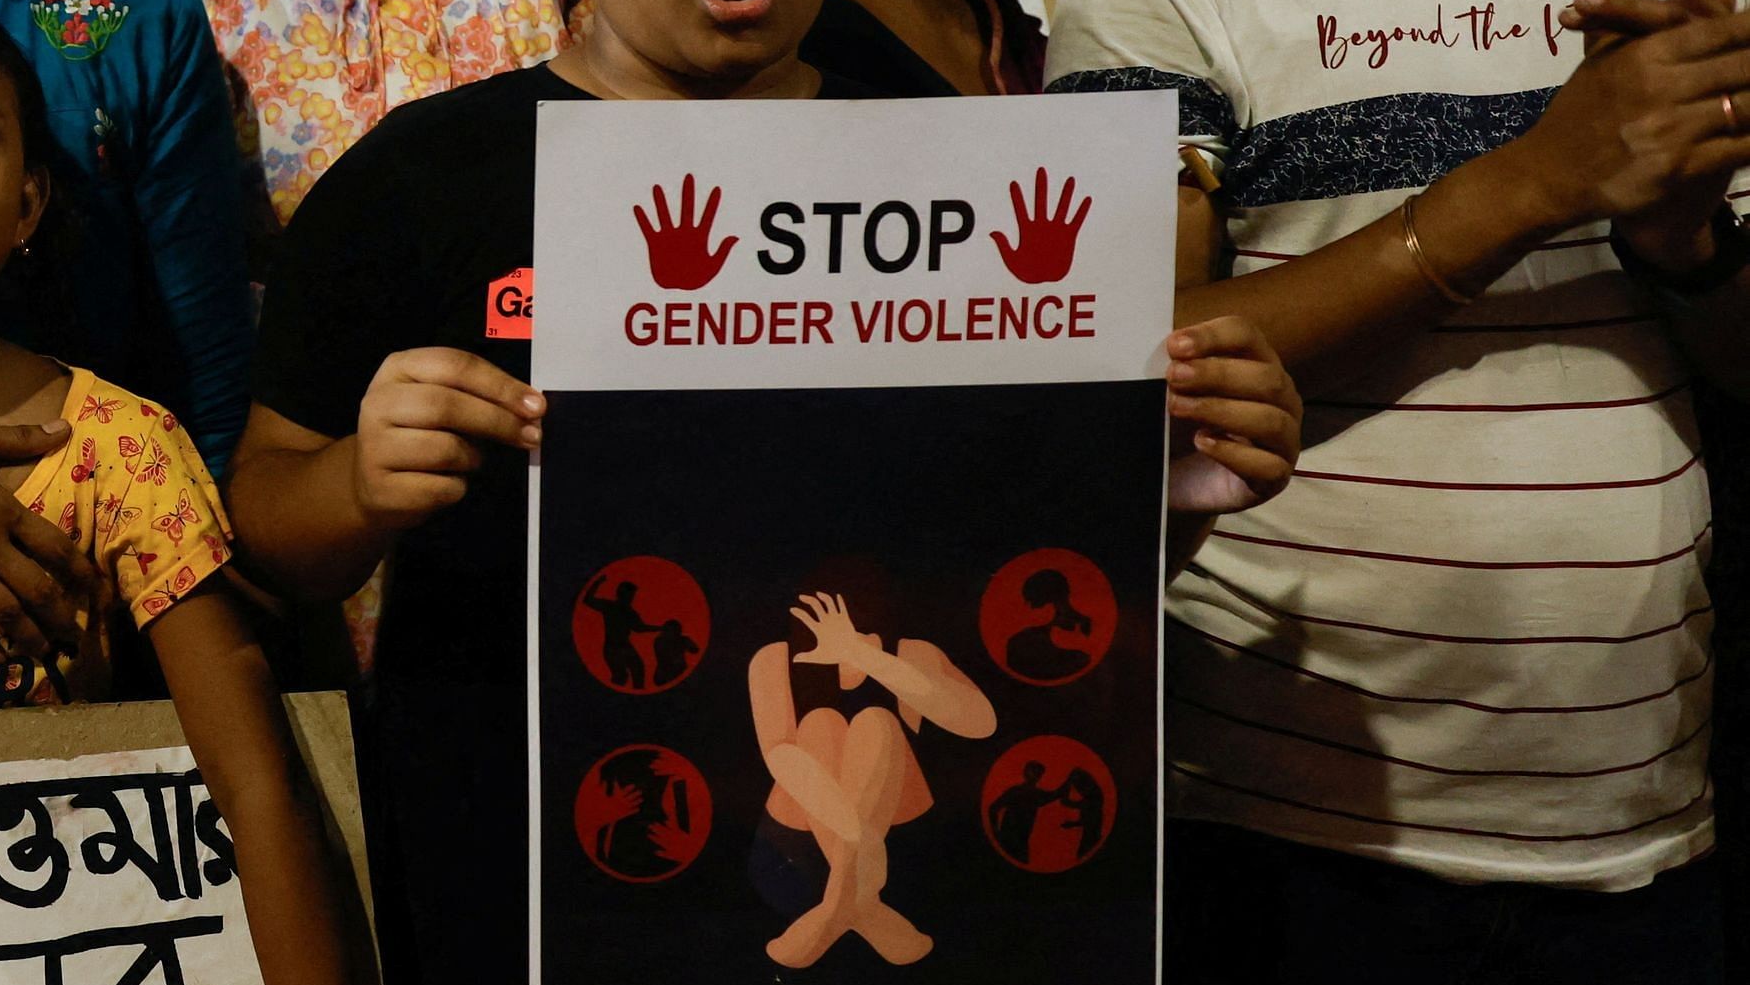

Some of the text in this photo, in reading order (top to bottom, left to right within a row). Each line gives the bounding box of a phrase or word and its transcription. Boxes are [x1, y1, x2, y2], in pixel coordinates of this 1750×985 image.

[1317, 3, 1459, 69] Beyond
[1455, 2, 1530, 51] the
[756, 200, 975, 275] STOP
[625, 294, 1096, 346] GENDER VIOLENCE
